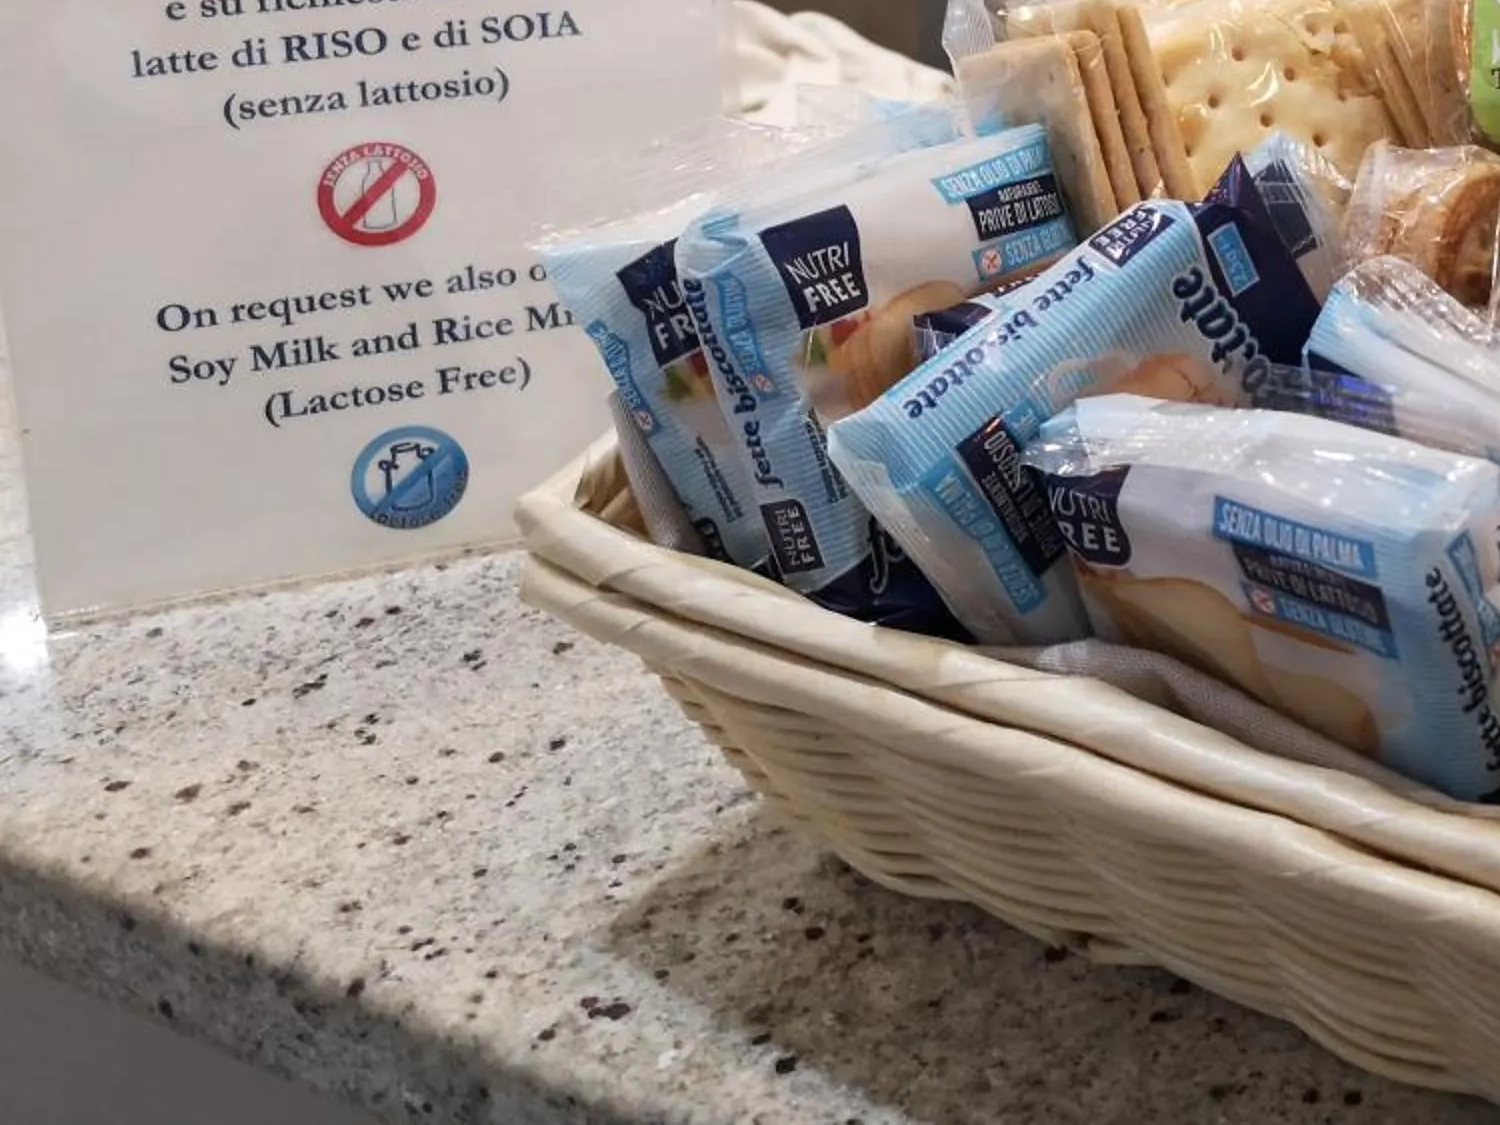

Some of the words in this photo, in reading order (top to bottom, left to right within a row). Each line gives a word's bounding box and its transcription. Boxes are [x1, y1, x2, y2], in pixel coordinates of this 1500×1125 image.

[130, 45, 219, 79] latte
[230, 39, 271, 70] di
[282, 28, 389, 64] RISO
[401, 29, 424, 53] e
[435, 20, 472, 49] di
[480, 11, 581, 46] SOIA
[223, 89, 347, 131] (senza
[358, 67, 512, 110] lattosio)
[1095, 210, 1147, 246] FREE
[785, 241, 851, 285] NUTRI
[803, 272, 861, 314] FREE
[1036, 256, 1095, 315] fette
[155, 303, 219, 334] On
[229, 284, 374, 332] request
[382, 276, 436, 301] we
[446, 263, 517, 291] also
[169, 352, 238, 386] Soy
[249, 336, 341, 375] Milk
[351, 323, 420, 358] and
[434, 310, 514, 346] Rice
[526, 301, 576, 332] Mi
[264, 380, 426, 428] (Lactose
[436, 357, 532, 401] Free)
[744, 420, 784, 489] fette
[774, 507, 801, 567] NUTRI
[787, 505, 816, 565] FREE
[1058, 520, 1121, 556] REE
[1220, 502, 1261, 540] SENZA
[1313, 532, 1364, 570] PALMA
[1425, 566, 1487, 714] biscottate
